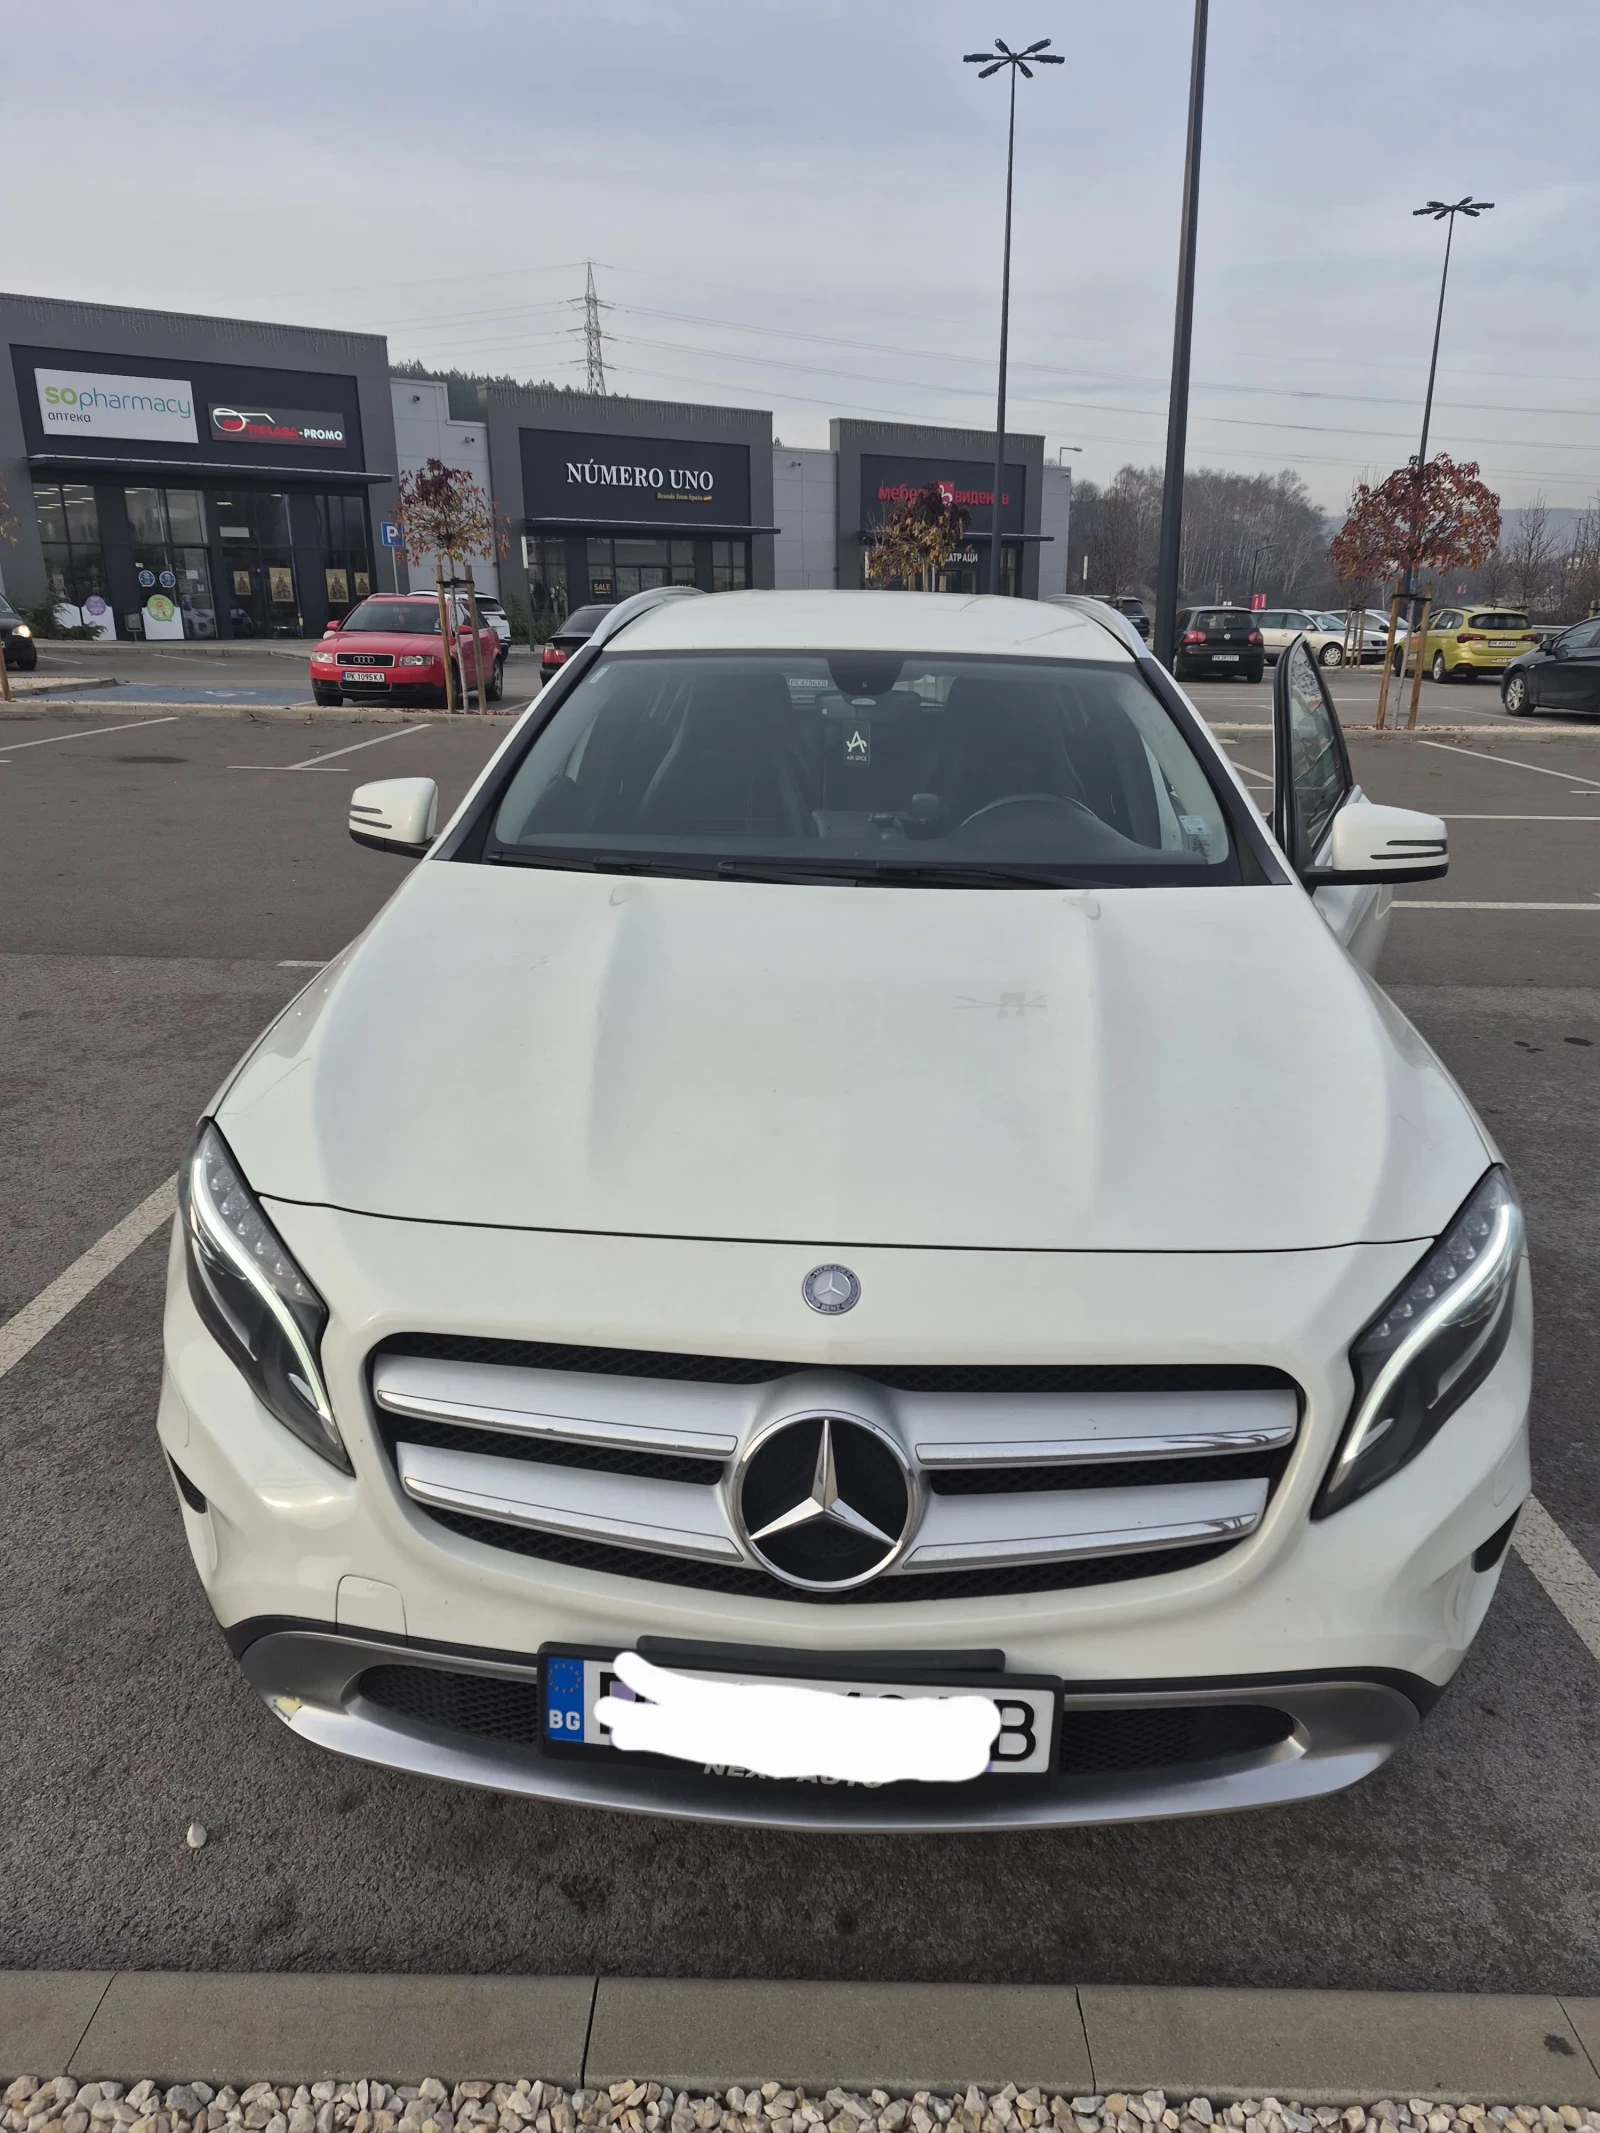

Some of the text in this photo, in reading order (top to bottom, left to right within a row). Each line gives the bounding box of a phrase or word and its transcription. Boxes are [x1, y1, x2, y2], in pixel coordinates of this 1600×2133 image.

[47, 411, 92, 423] аптека
[565, 458, 714, 491] NÚMERO UNO
[956, 489, 1010, 506] виденв
[593, 583, 611, 591] SALE
[549, 1709, 581, 1731] BG
